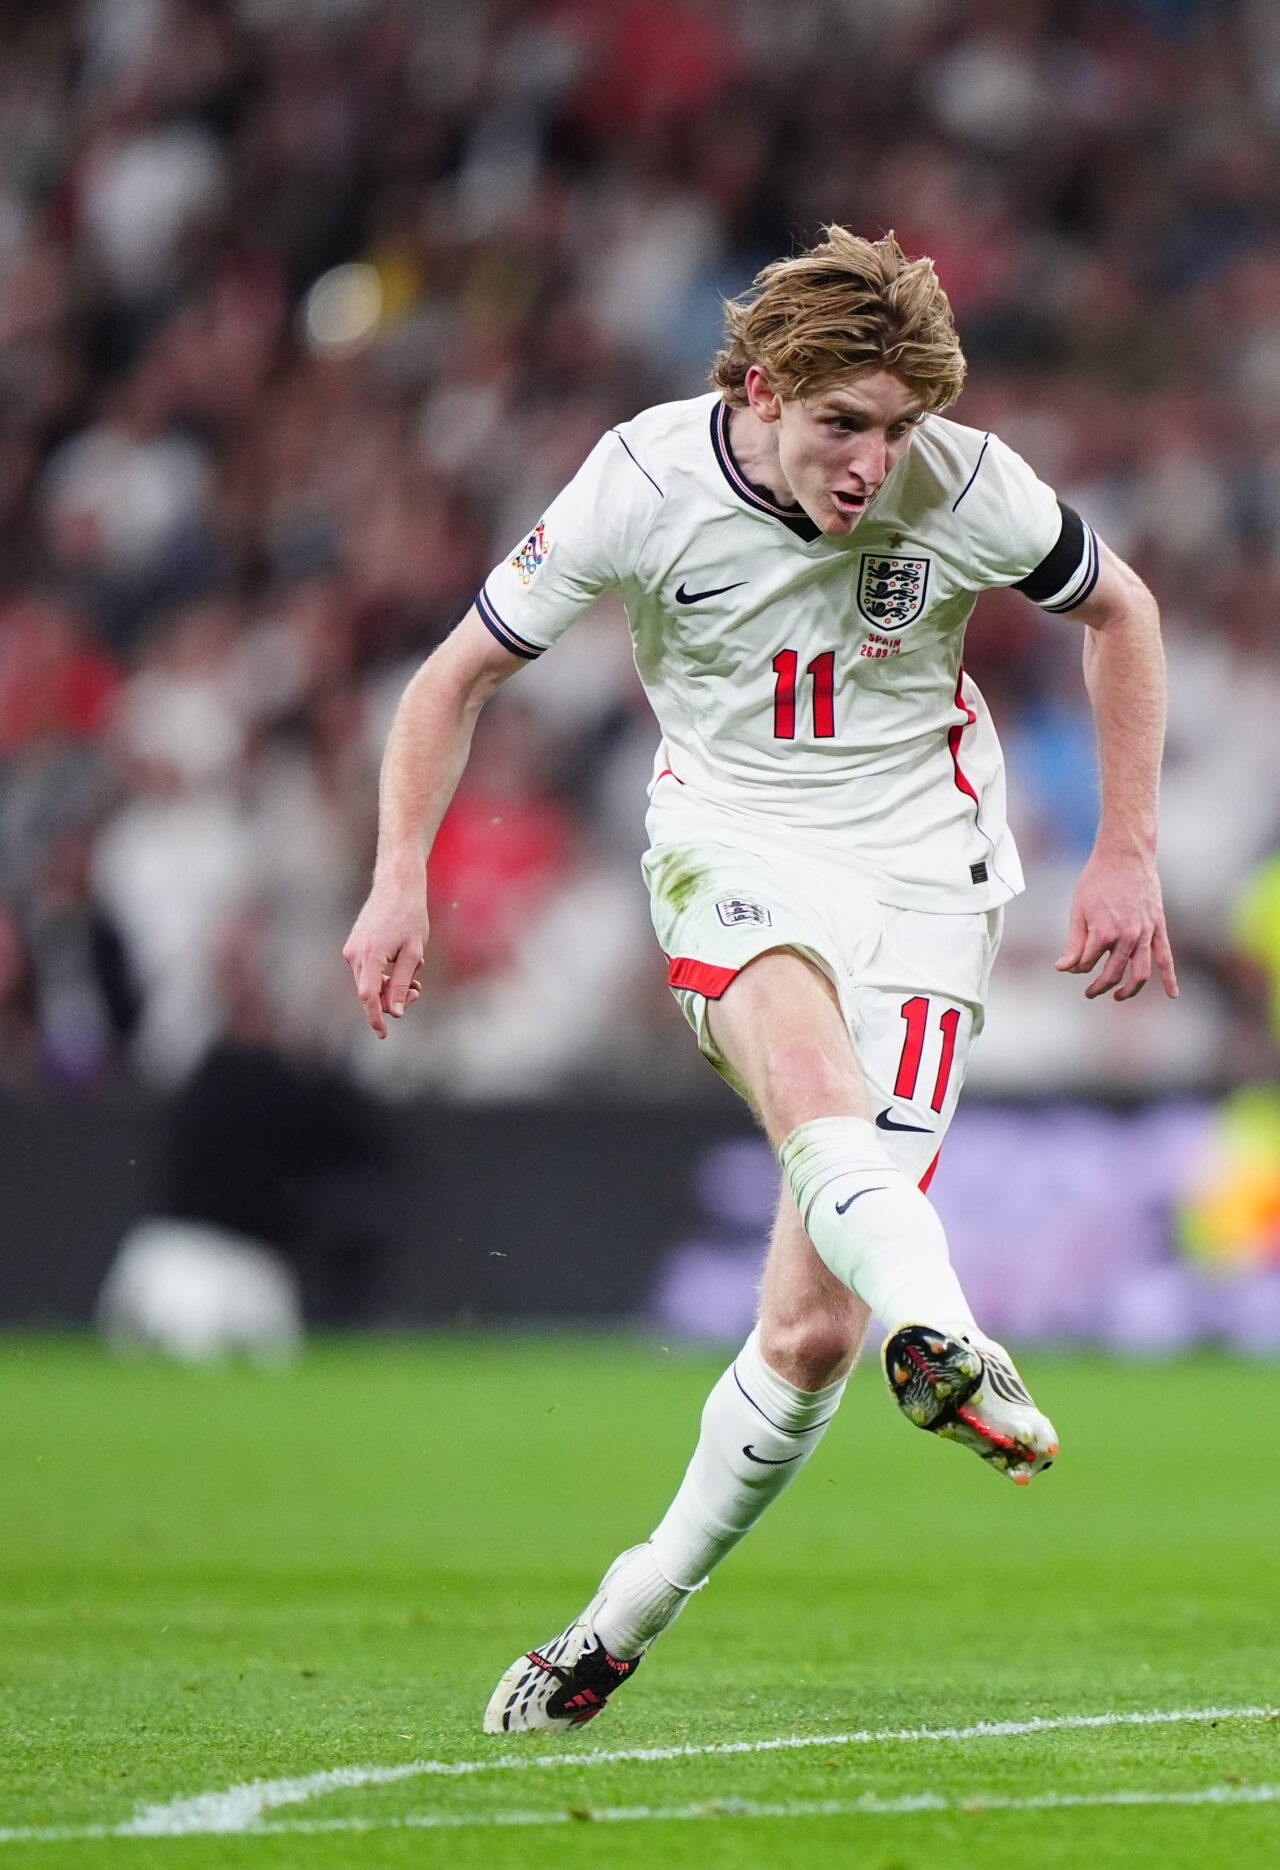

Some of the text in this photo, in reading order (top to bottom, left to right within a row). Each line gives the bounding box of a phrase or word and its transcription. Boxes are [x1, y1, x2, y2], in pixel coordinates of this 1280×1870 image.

[860, 643, 901, 659] 26.09
[868, 633, 902, 648] SPAIN
[772, 648, 836, 740] 11
[893, 996, 960, 1114] 11
